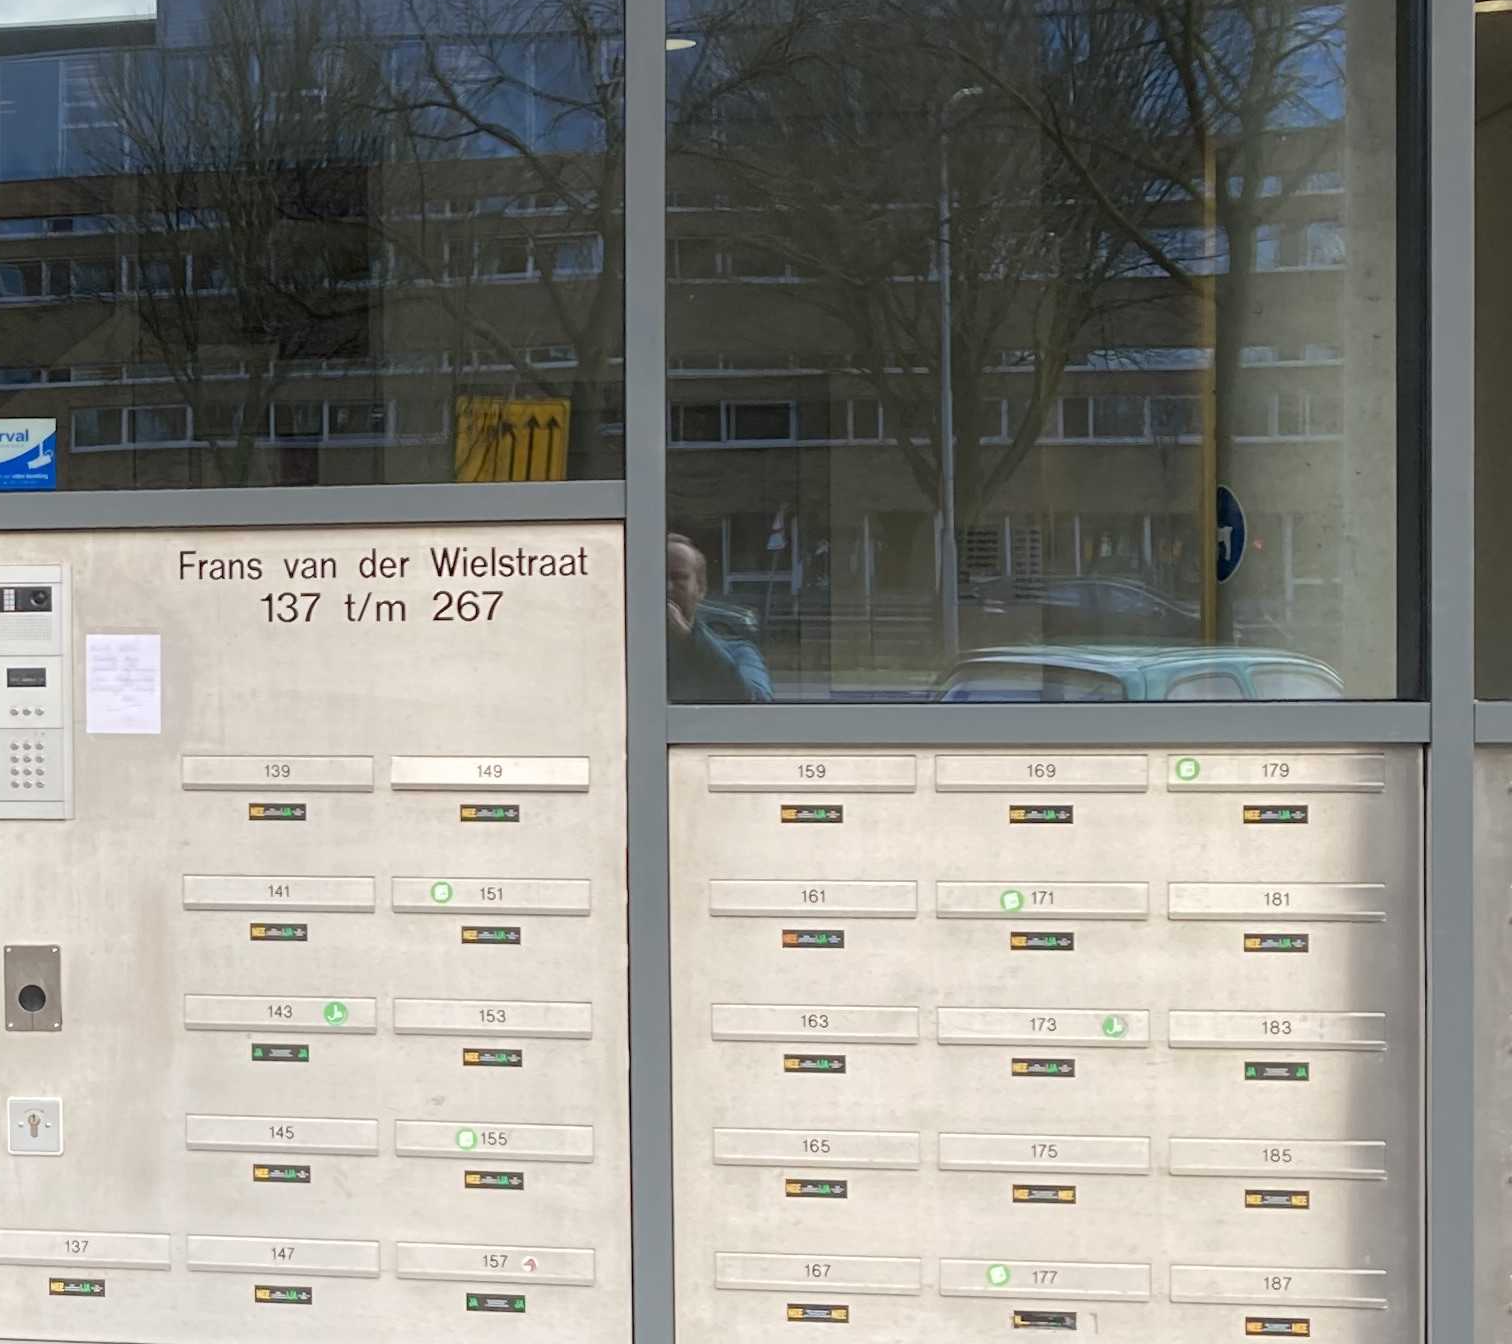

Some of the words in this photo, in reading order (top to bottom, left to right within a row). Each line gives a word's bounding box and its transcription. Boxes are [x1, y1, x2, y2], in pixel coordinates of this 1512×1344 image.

[180, 551, 262, 580] Frans
[284, 558, 336, 579] van
[359, 548, 410, 578] der
[430, 547, 588, 577] Wielstraat
[261, 592, 320, 622] 137
[345, 592, 405, 621] t/m
[433, 591, 503, 621] 267
[264, 763, 291, 779] 139
[476, 764, 503, 779] 149
[797, 763, 827, 779] 159
[1026, 763, 1057, 779] 169
[1261, 762, 1291, 778] 179
[267, 884, 291, 898] 141
[479, 886, 503, 901] 151
[801, 888, 826, 904] 161
[1031, 890, 1054, 905] 171
[1263, 891, 1290, 907] 181
[267, 1004, 293, 1019] 143
[479, 1008, 507, 1024] 153
[800, 1013, 830, 1029] 163
[1029, 1017, 1057, 1032] 173
[1261, 1019, 1293, 1036] 183
[268, 1125, 295, 1140] 145
[480, 1131, 509, 1147] 155
[802, 1138, 831, 1154] 165
[1031, 1143, 1059, 1159] 175
[1262, 1147, 1293, 1164] 185
[64, 1239, 89, 1254] 137
[271, 1246, 296, 1261] 147
[482, 1254, 509, 1269] 157
[804, 1263, 832, 1279] 167
[1031, 1270, 1059, 1285] 177
[1263, 1276, 1293, 1292] 187
